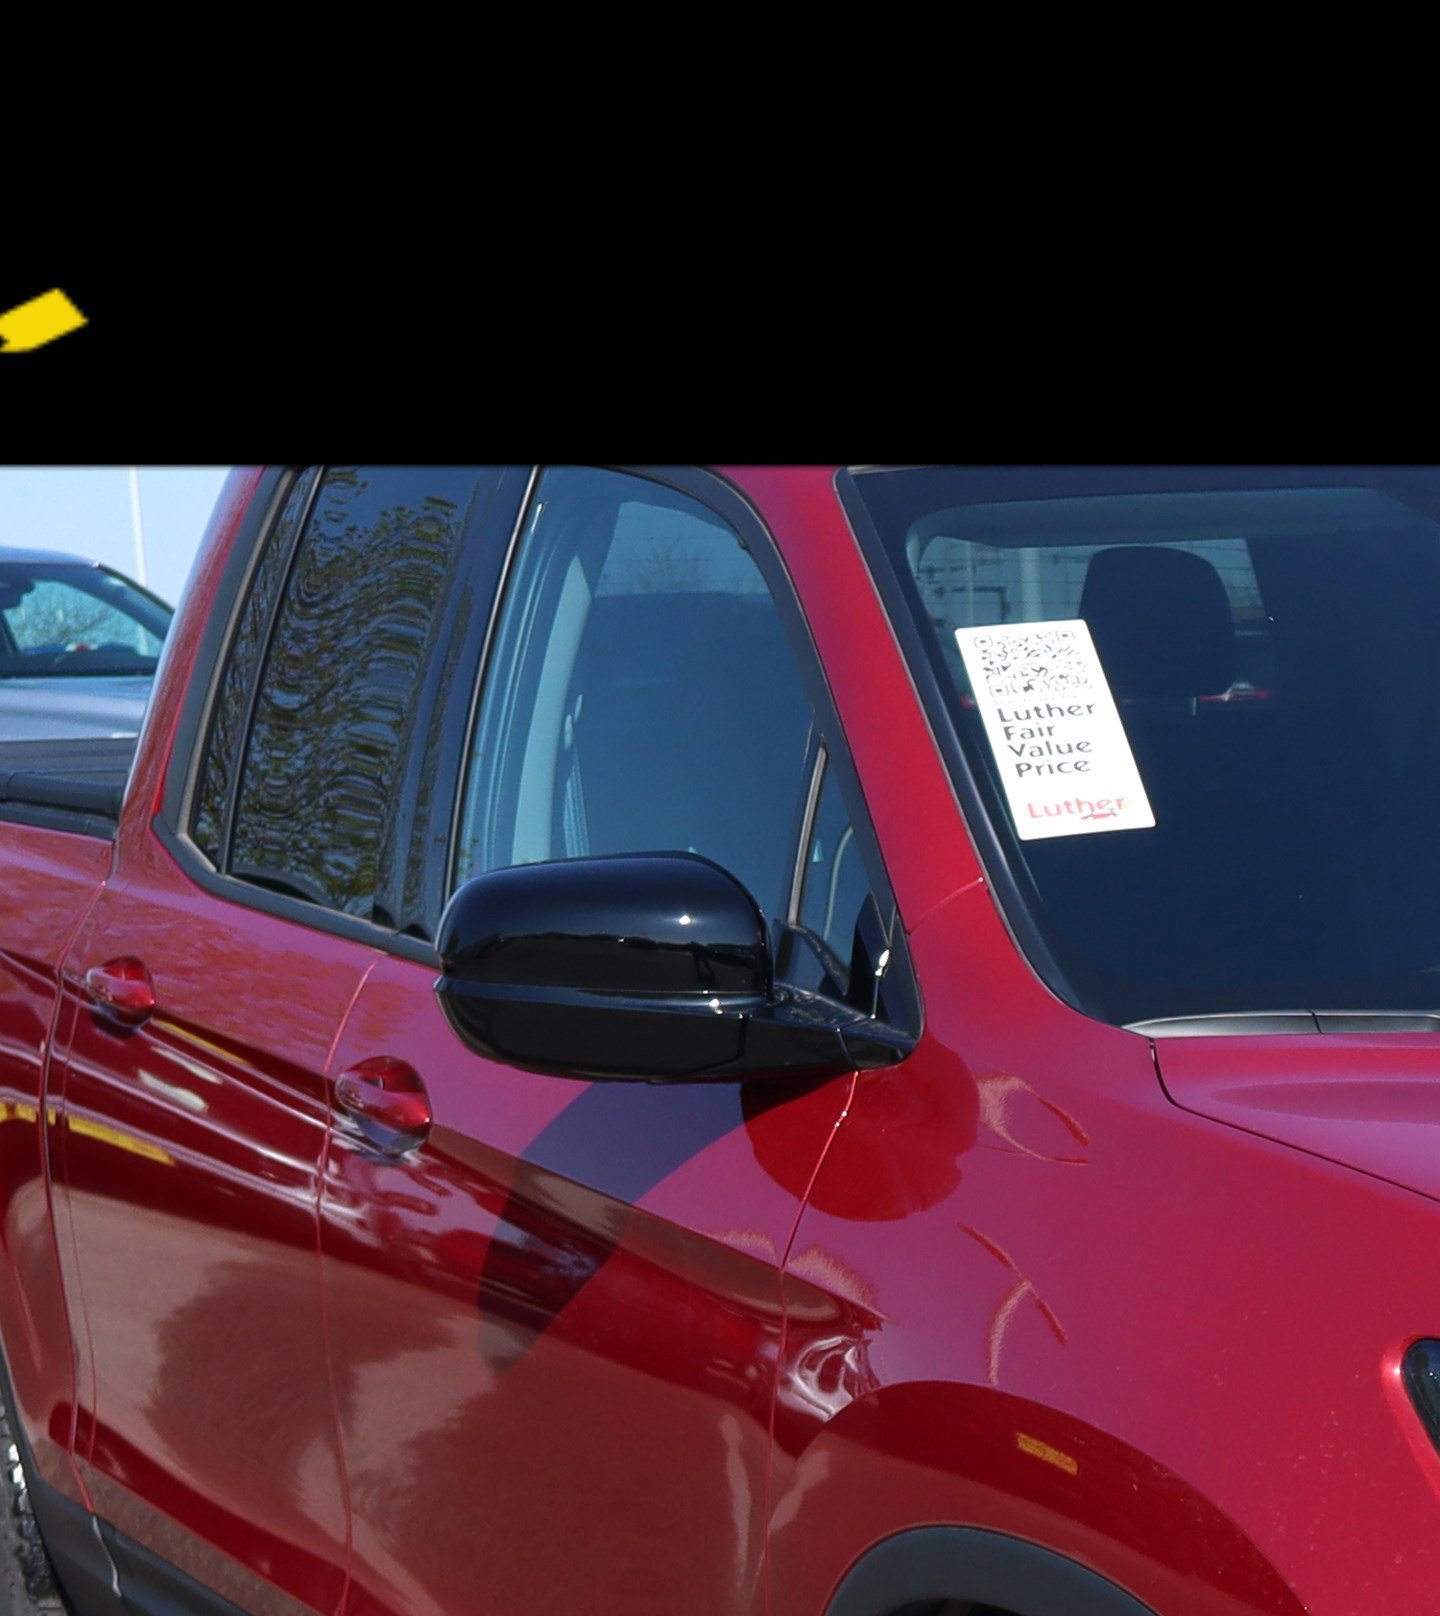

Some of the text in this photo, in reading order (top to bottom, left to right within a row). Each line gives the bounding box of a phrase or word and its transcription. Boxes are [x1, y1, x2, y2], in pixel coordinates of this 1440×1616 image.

[997, 703, 1096, 722] Luther
[1003, 723, 1056, 741] Fair
[1007, 740, 1093, 758] Value
[1015, 759, 1091, 778] Price
[1026, 796, 1126, 819] Luther
